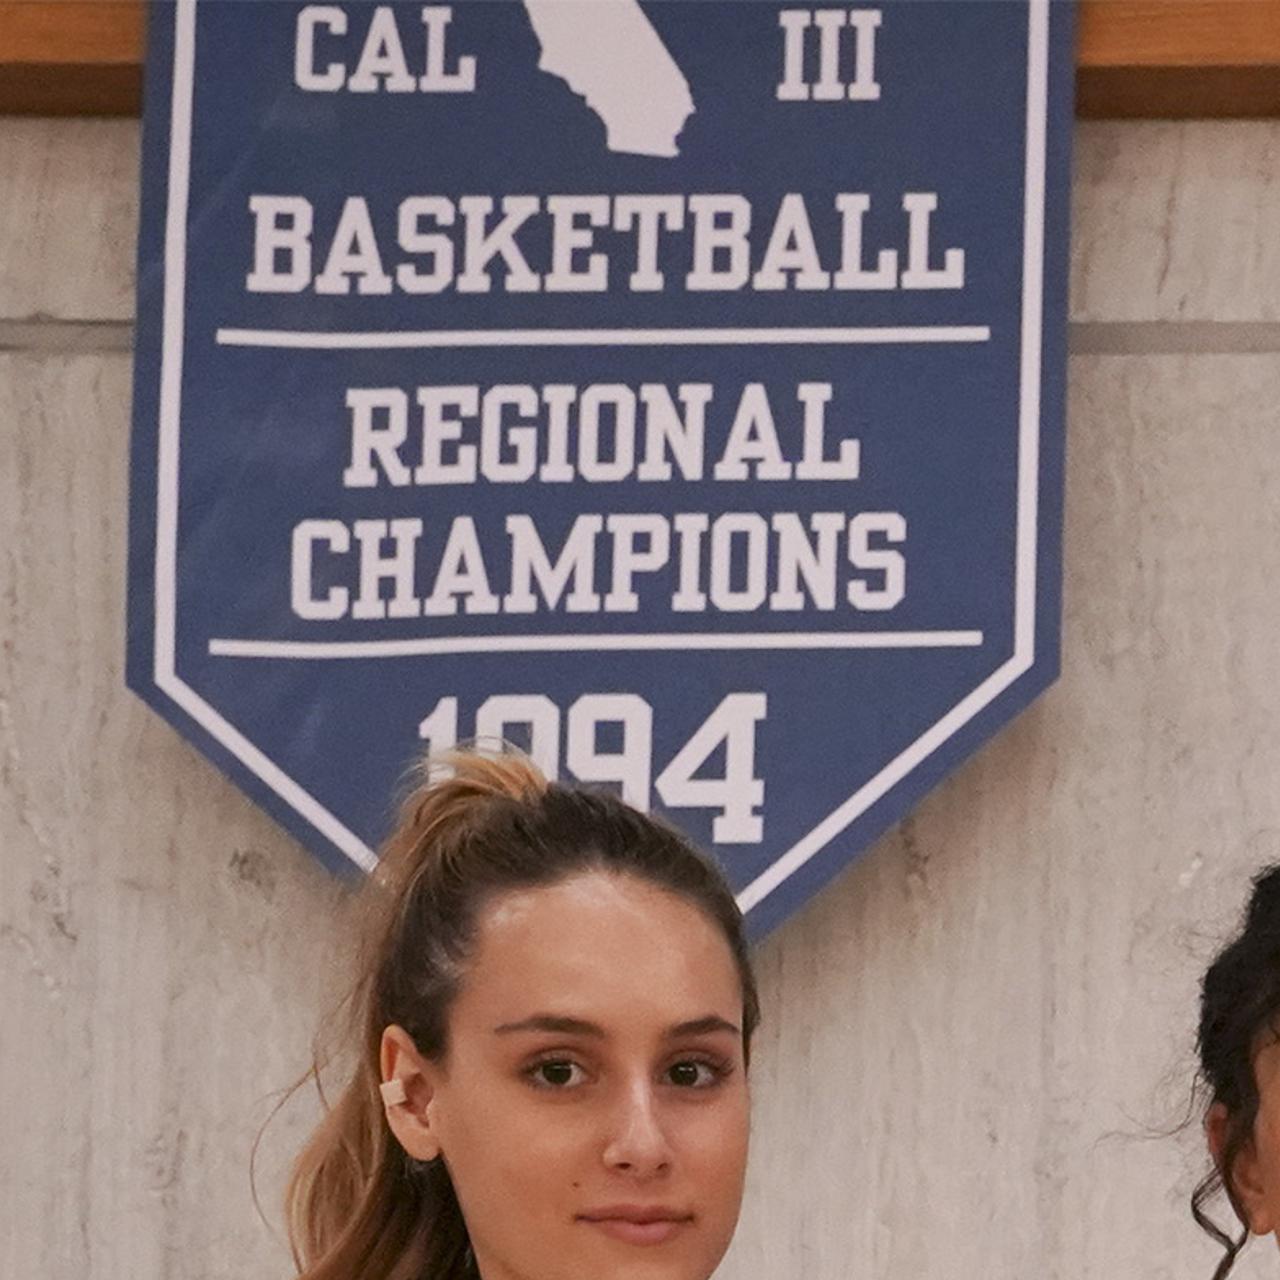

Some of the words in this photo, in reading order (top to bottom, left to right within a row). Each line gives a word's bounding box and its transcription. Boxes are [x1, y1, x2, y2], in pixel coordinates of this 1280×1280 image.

[294, 6, 476, 93] CAL
[777, 10, 882, 101] III
[246, 193, 965, 295] BASKETBALL
[343, 382, 861, 487] REGIONAL
[290, 511, 907, 620] CHAMPIONS
